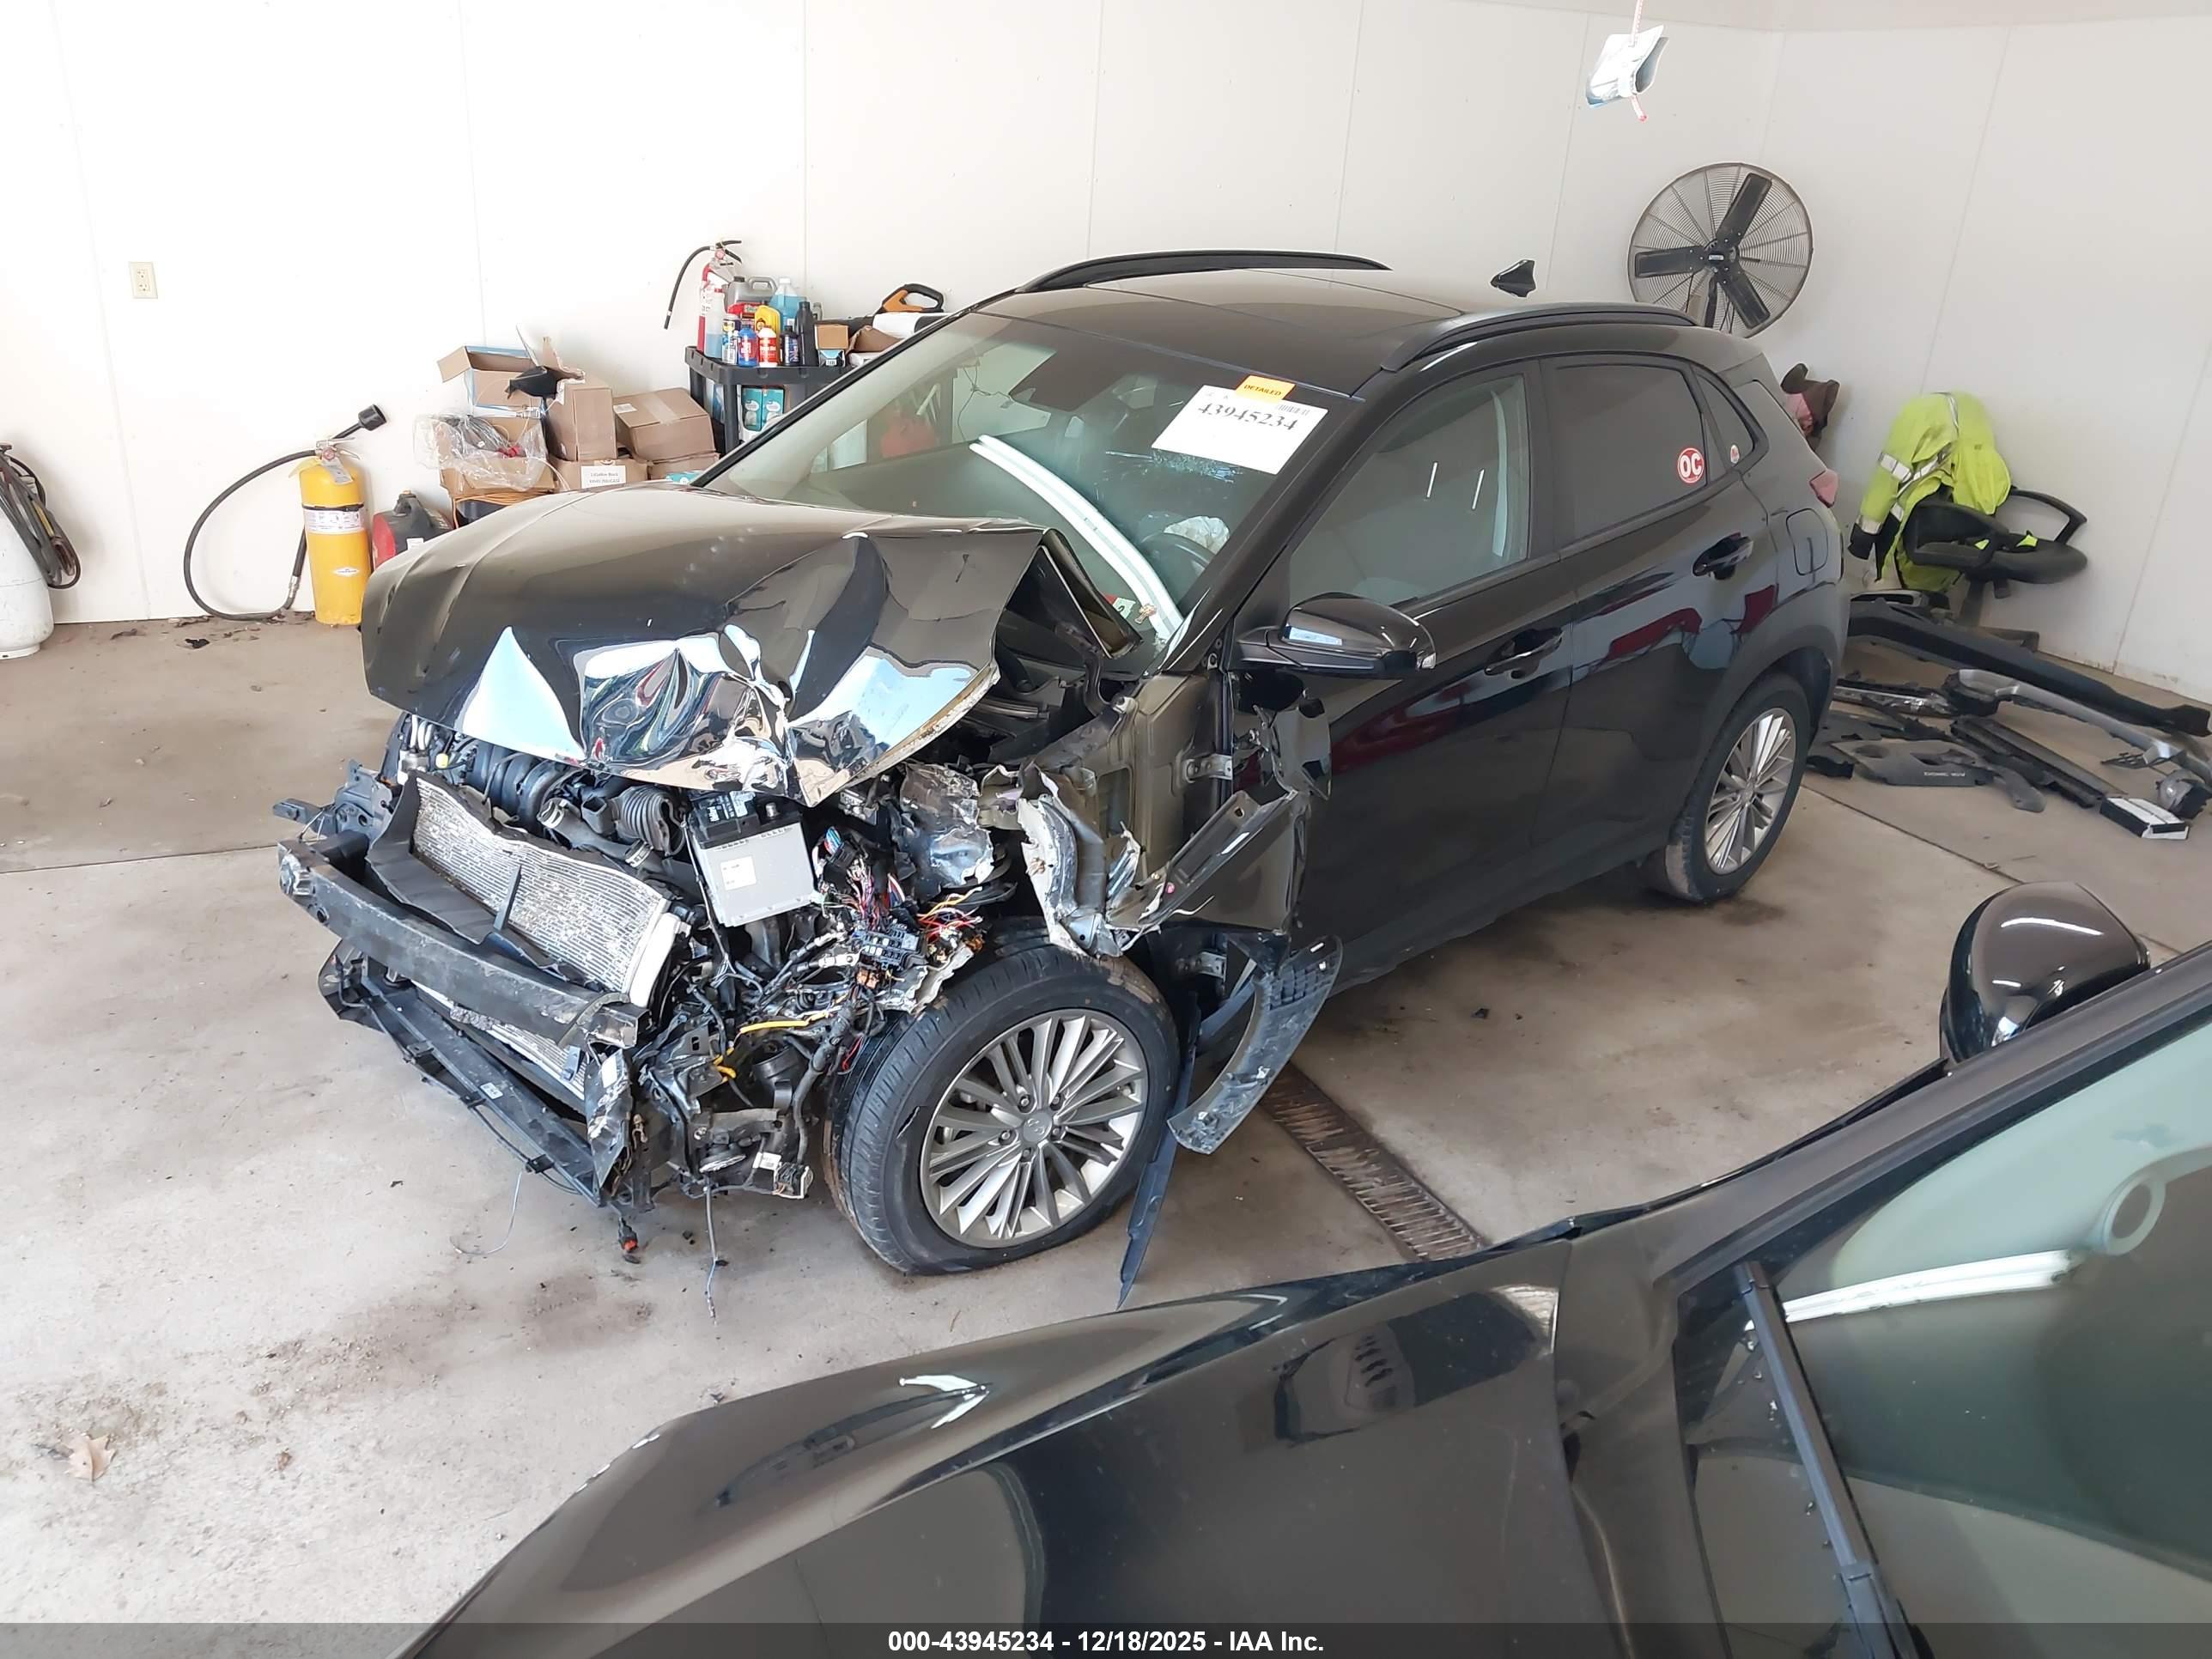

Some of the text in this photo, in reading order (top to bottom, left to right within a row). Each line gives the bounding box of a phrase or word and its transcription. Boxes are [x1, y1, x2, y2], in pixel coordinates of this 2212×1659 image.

[1243, 384, 1282, 396] DETAILED
[1197, 403, 1298, 430] 43945234
[1680, 453, 1702, 477] OC
